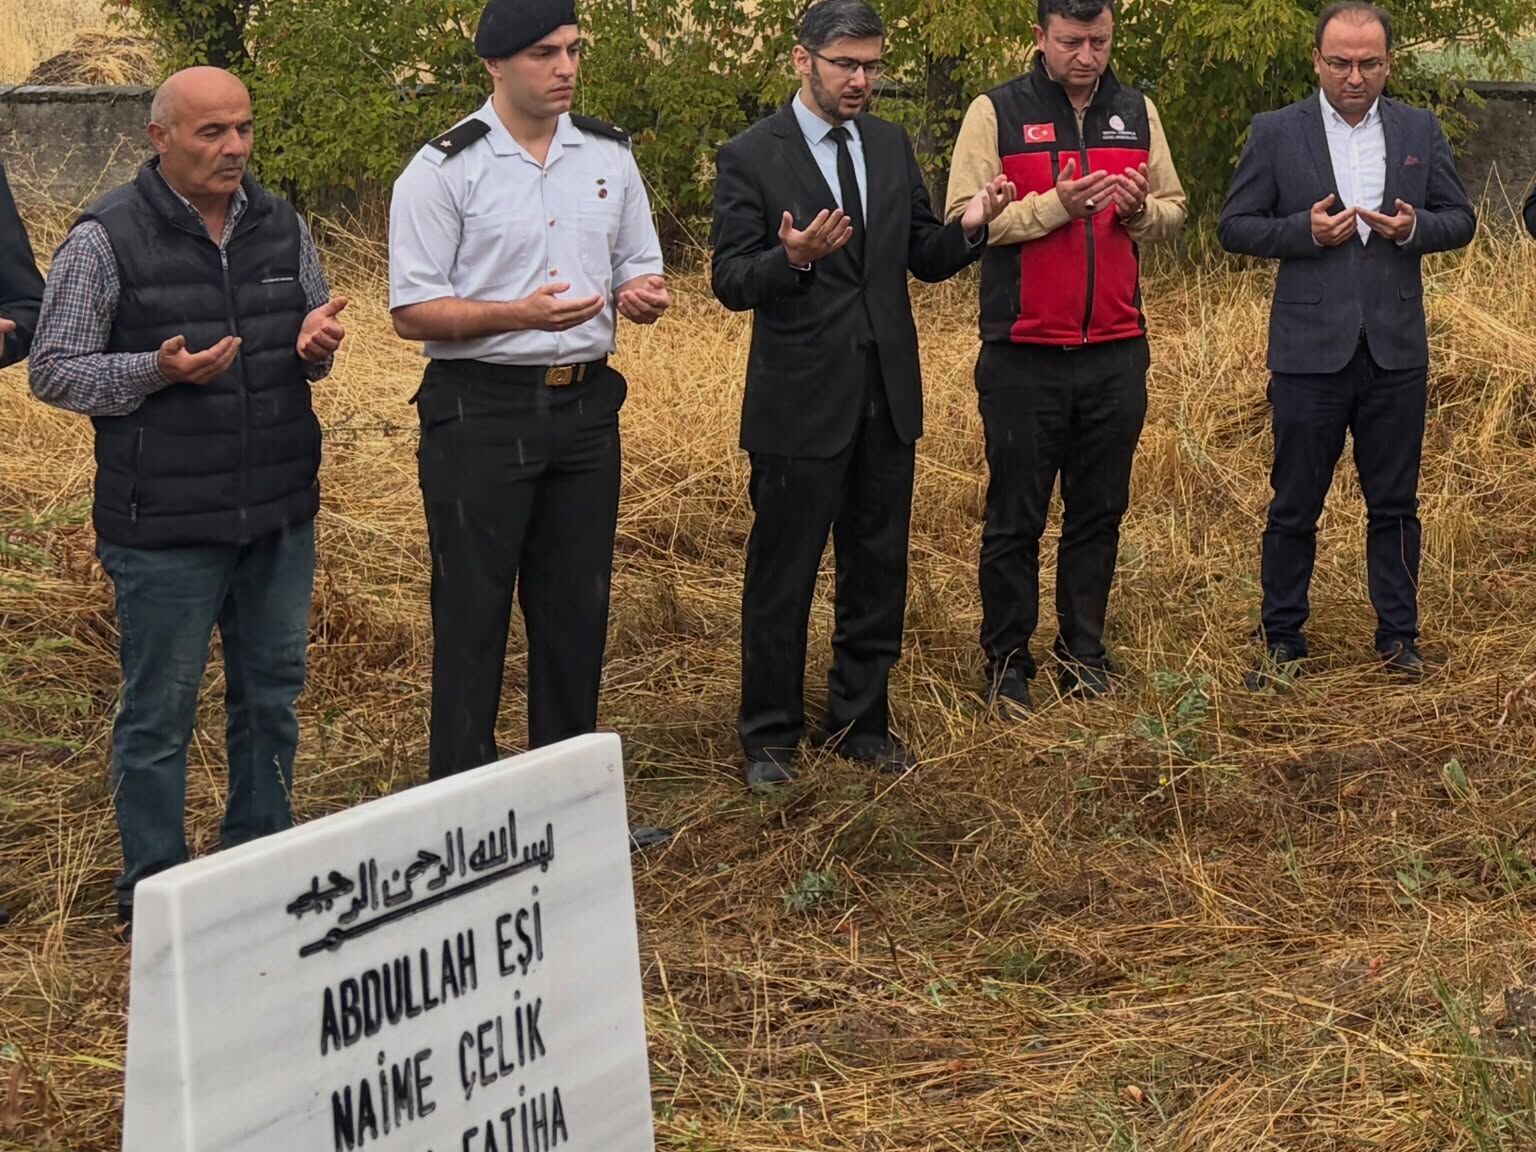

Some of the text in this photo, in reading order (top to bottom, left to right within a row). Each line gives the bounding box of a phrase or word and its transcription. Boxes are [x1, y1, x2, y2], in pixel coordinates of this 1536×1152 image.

[320, 884, 544, 1057] ABDULLAH EŞİ
[331, 989, 546, 1152] NAİME ÇELİK
